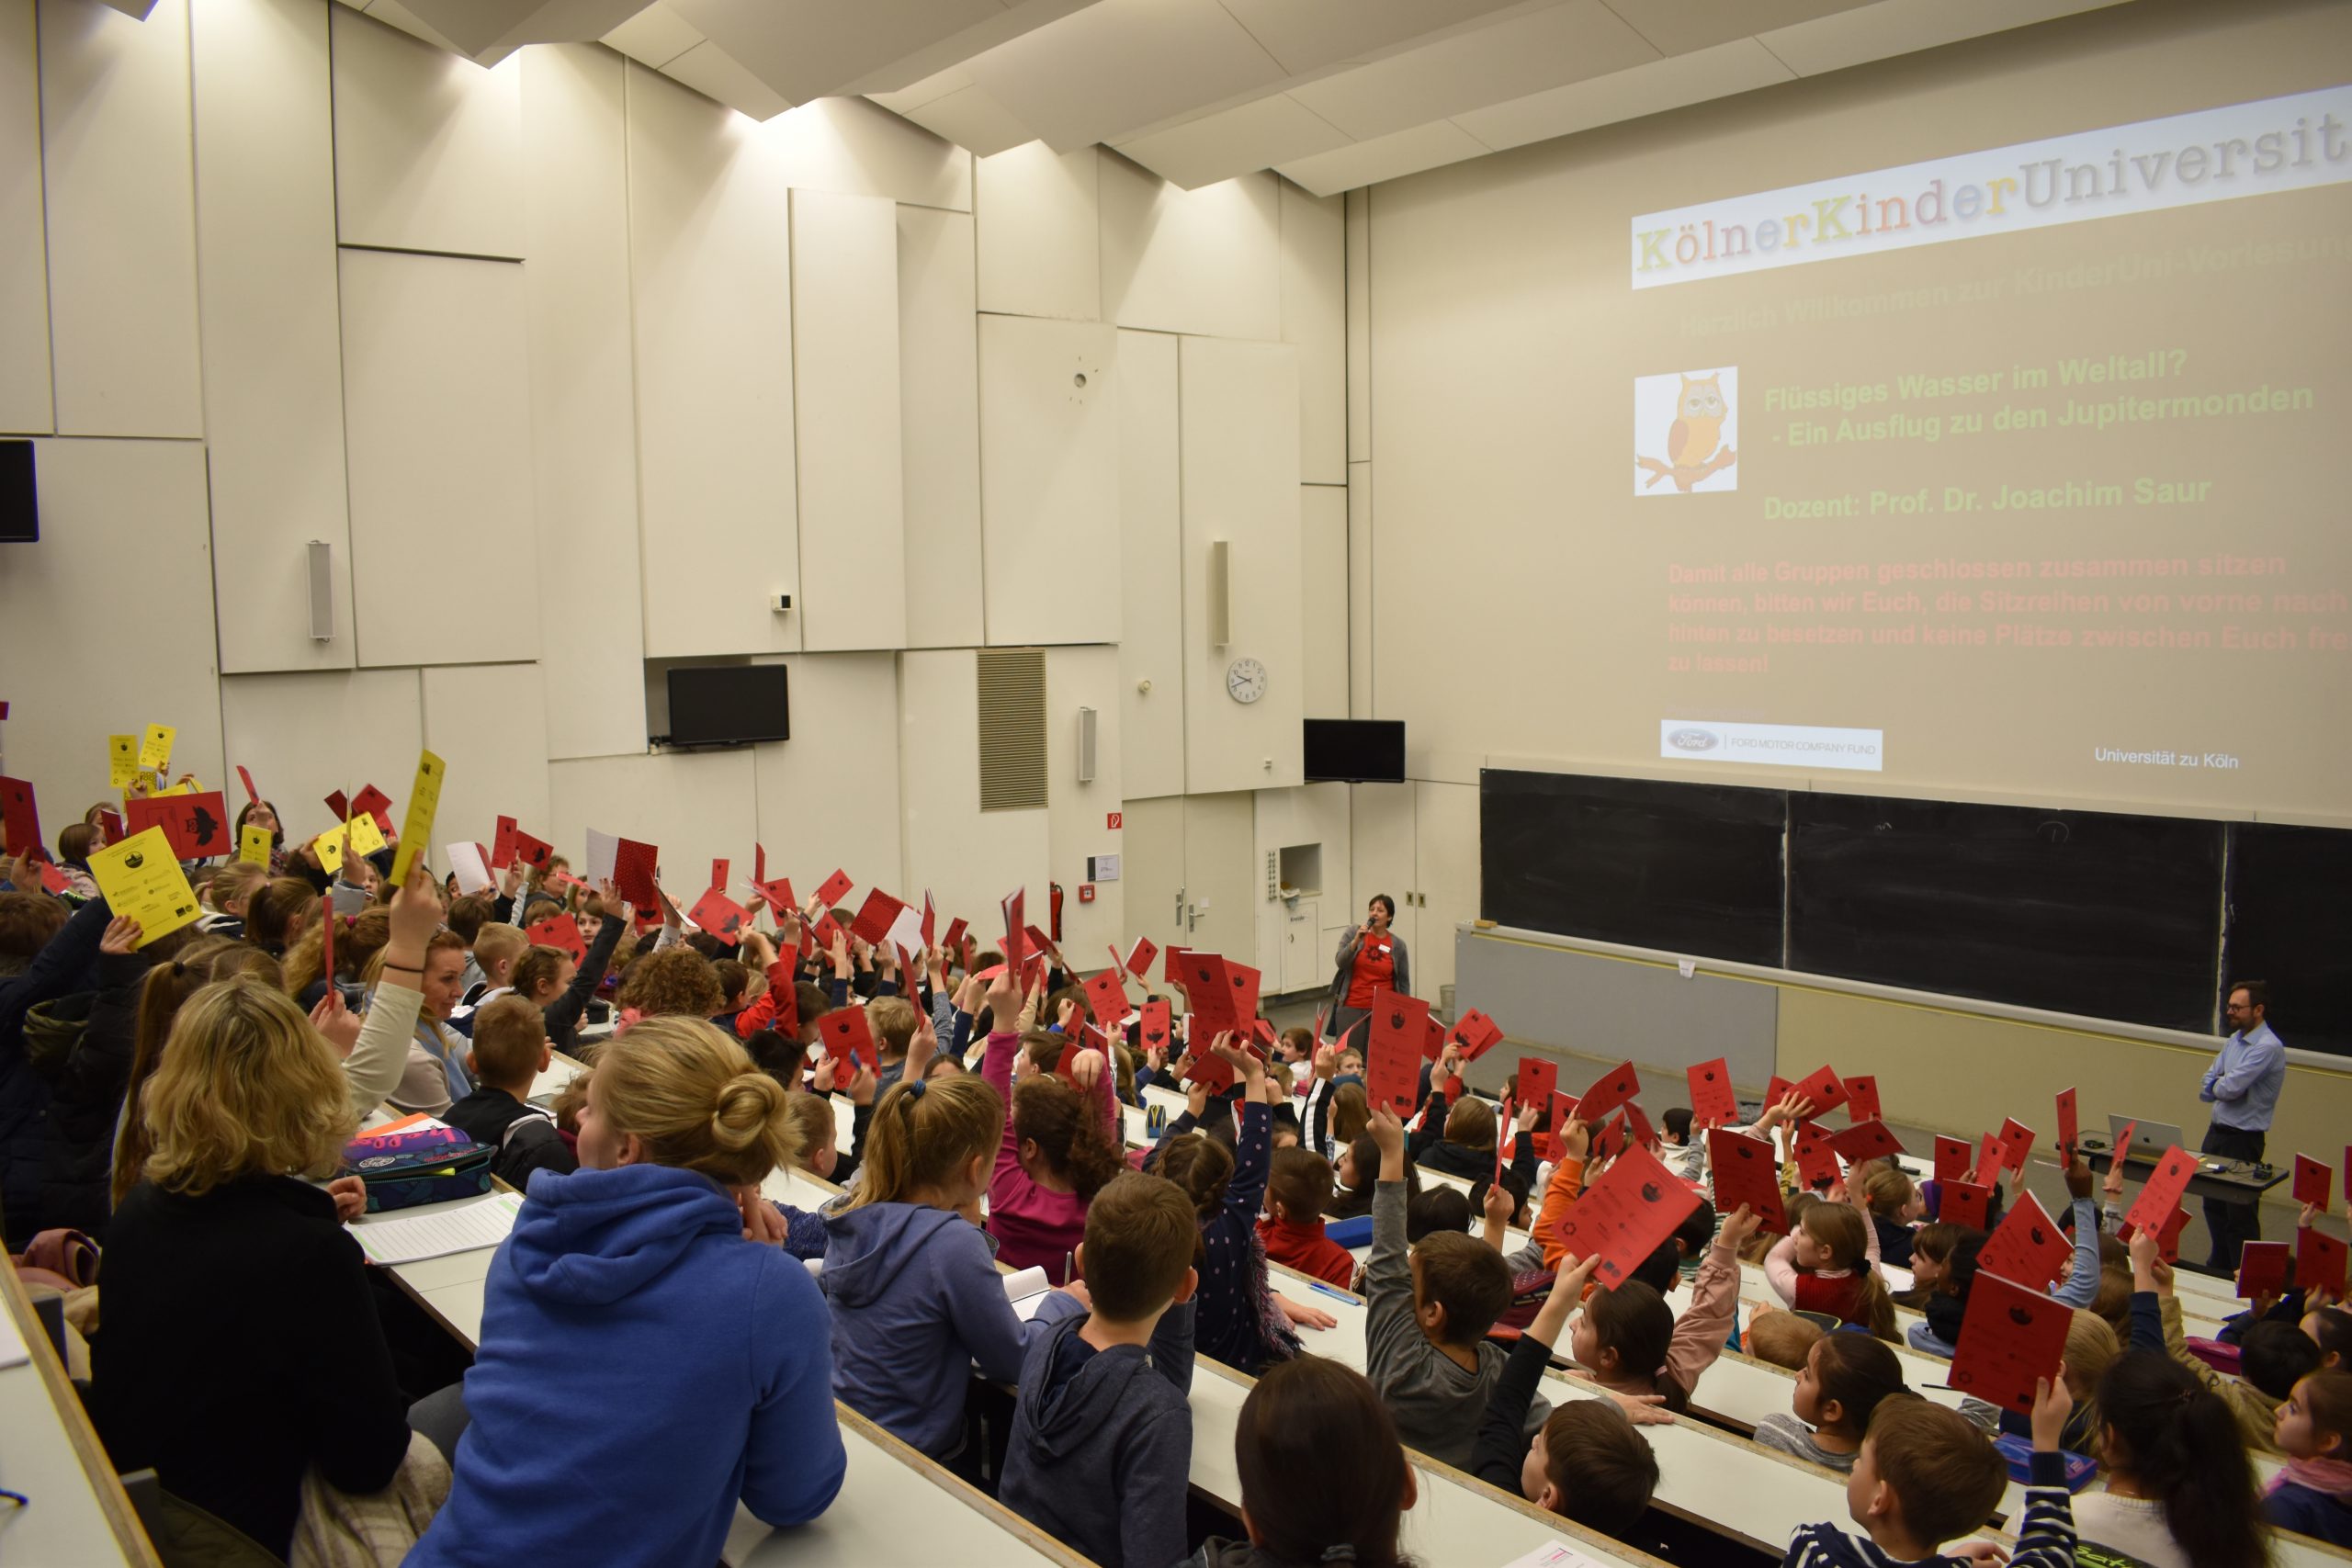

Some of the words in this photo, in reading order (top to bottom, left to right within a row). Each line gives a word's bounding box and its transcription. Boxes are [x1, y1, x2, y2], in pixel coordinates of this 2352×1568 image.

[1680, 303, 1779, 339] Herzlich
[1785, 284, 1950, 323] Willkommen
[1958, 277, 2007, 303] zur
[1765, 382, 1888, 412] Flüssiges
[1897, 370, 2005, 400] Wasser
[2012, 365, 2049, 389] im
[2057, 348, 2188, 386] Weltall?
[1788, 421, 1828, 446] Ein
[1835, 413, 1941, 443] Ausflug
[1950, 412, 1984, 434] zu
[1993, 404, 2048, 432] den
[2057, 384, 2313, 431] Jupitermonden
[1764, 493, 1860, 520] Dozent:
[1870, 488, 1935, 515] Prof.
[1943, 486, 1984, 513] Dr.
[1992, 480, 2123, 511] Joachim
[2133, 476, 2213, 505] Saur
[1668, 561, 1727, 584] Damit
[1732, 562, 1769, 582] alle
[1774, 559, 1871, 586] Gruppen
[1877, 558, 2032, 585] geschlossen
[2039, 558, 2189, 579] zusammen
[2198, 554, 2288, 577] sitzen
[1668, 592, 1748, 615] können,
[1754, 592, 1815, 614] bitten
[1821, 592, 1856, 613] wir
[1861, 591, 1928, 615] Euch,
[1935, 591, 1973, 613] die
[1979, 589, 2110, 614] Sitzreihen
[2117, 595, 2171, 613] von
[2177, 595, 2264, 614] vorne
[2272, 590, 2349, 614] nach
[1668, 623, 1730, 643] hinten
[1736, 626, 1760, 643] zu
[1766, 623, 1865, 645] besetzen
[1871, 624, 1917, 645] und
[1922, 623, 1987, 646] keine
[1995, 622, 2074, 648] Plätze
[2081, 625, 2212, 649] zwischen
[2221, 625, 2299, 650] Euch
[2308, 625, 2352, 651] fre
[1668, 655, 1690, 672] zu
[1697, 652, 1770, 673] lassen!
[1677, 732, 1709, 749] Ford
[1731, 737, 1758, 749] FORD
[1758, 739, 1796, 751] MOTOR
[1795, 740, 1846, 754] COMPANY
[1847, 743, 1876, 755] FUND
[2095, 747, 2177, 766] Universität
[2179, 753, 2199, 767] zu
[2203, 752, 2239, 770] Köln
